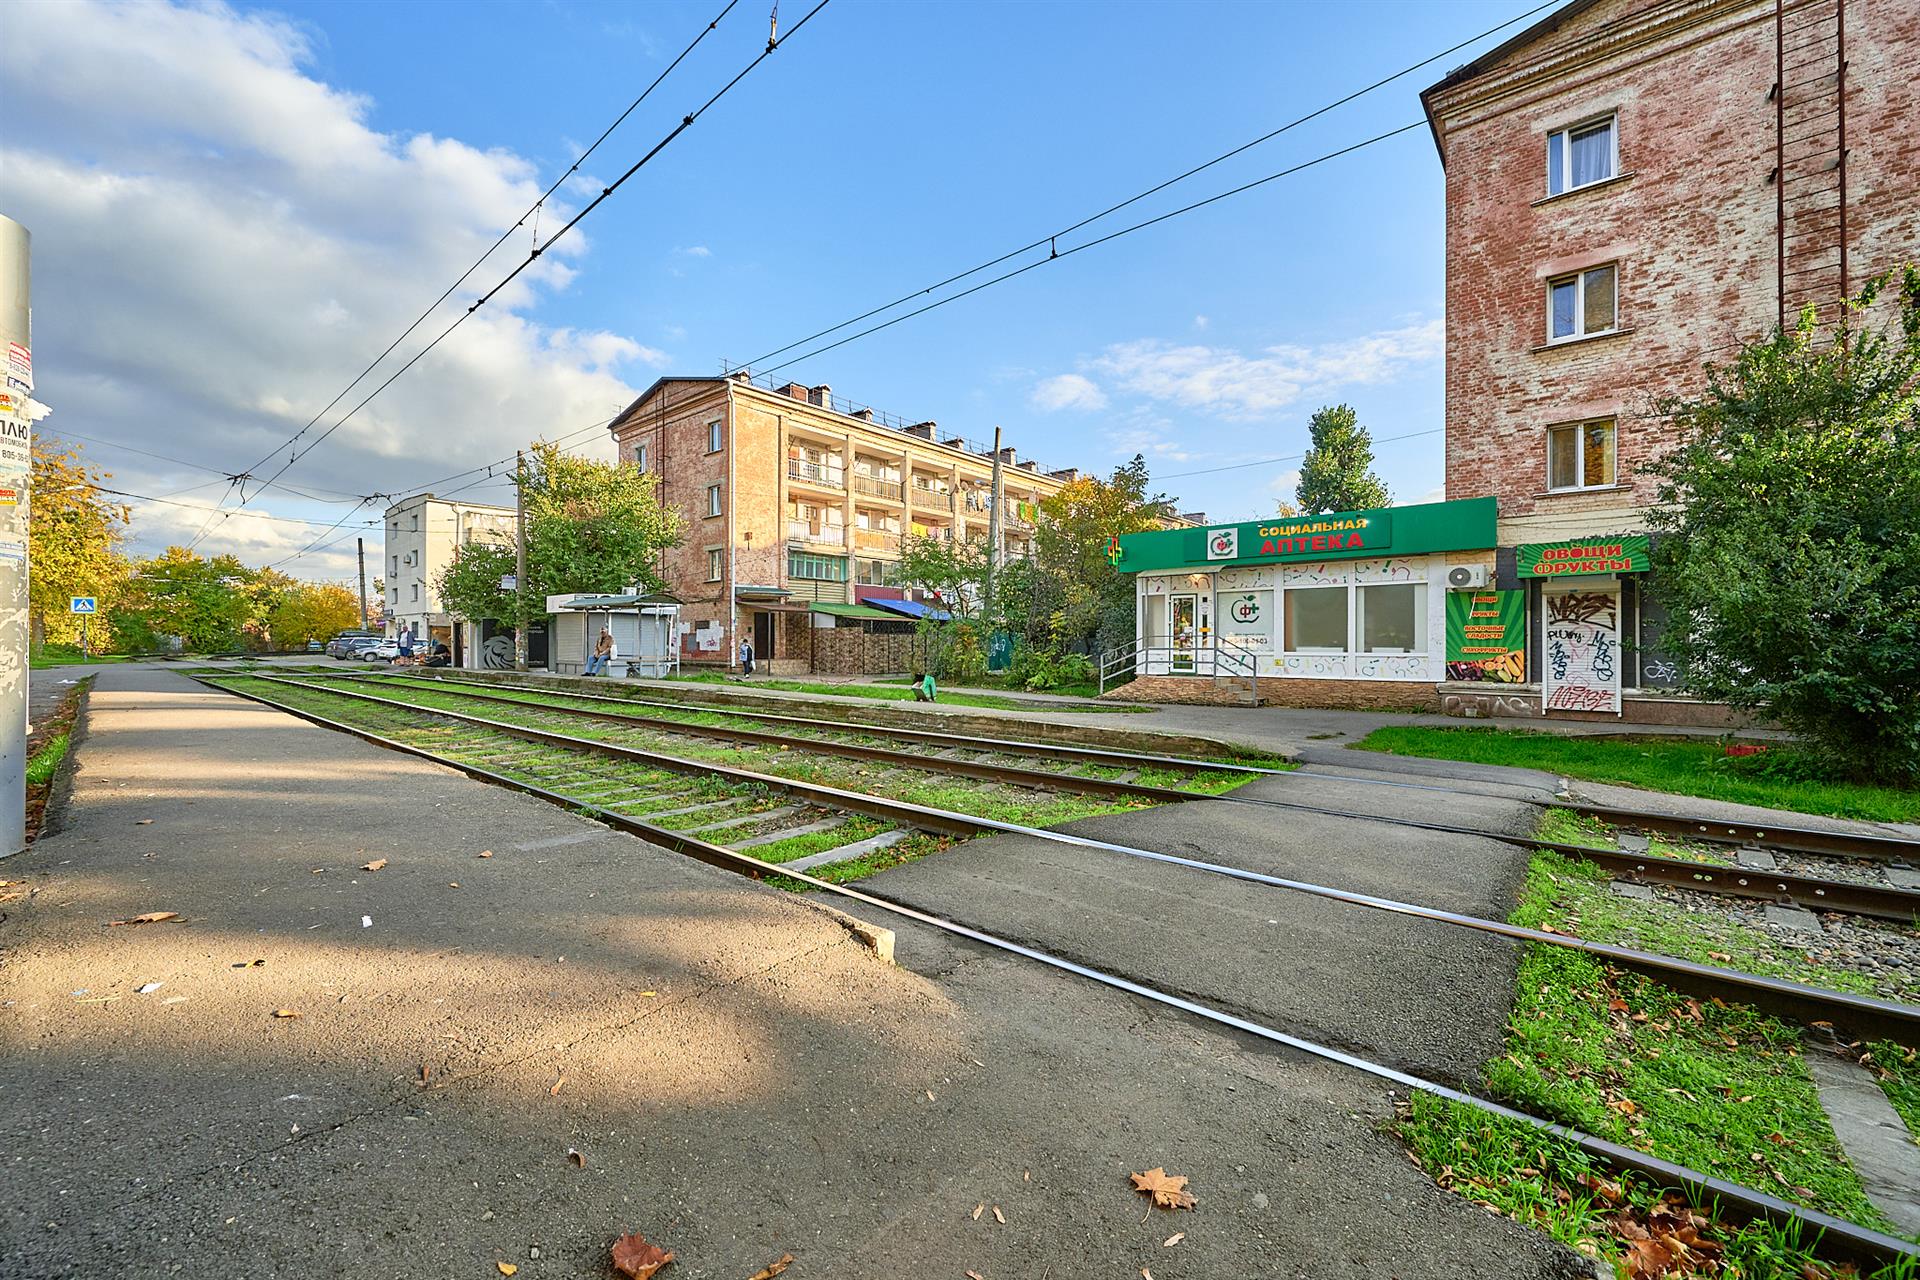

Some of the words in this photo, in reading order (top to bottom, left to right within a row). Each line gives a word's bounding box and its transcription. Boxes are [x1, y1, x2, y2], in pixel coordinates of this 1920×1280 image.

[1259, 518, 1367, 537] СОЦИАЛЬНАЯ
[1260, 533, 1364, 554] АПТЕКА
[1543, 544, 1622, 561] ОВОЩИ
[1533, 558, 1631, 574] ФРУКТЫ
